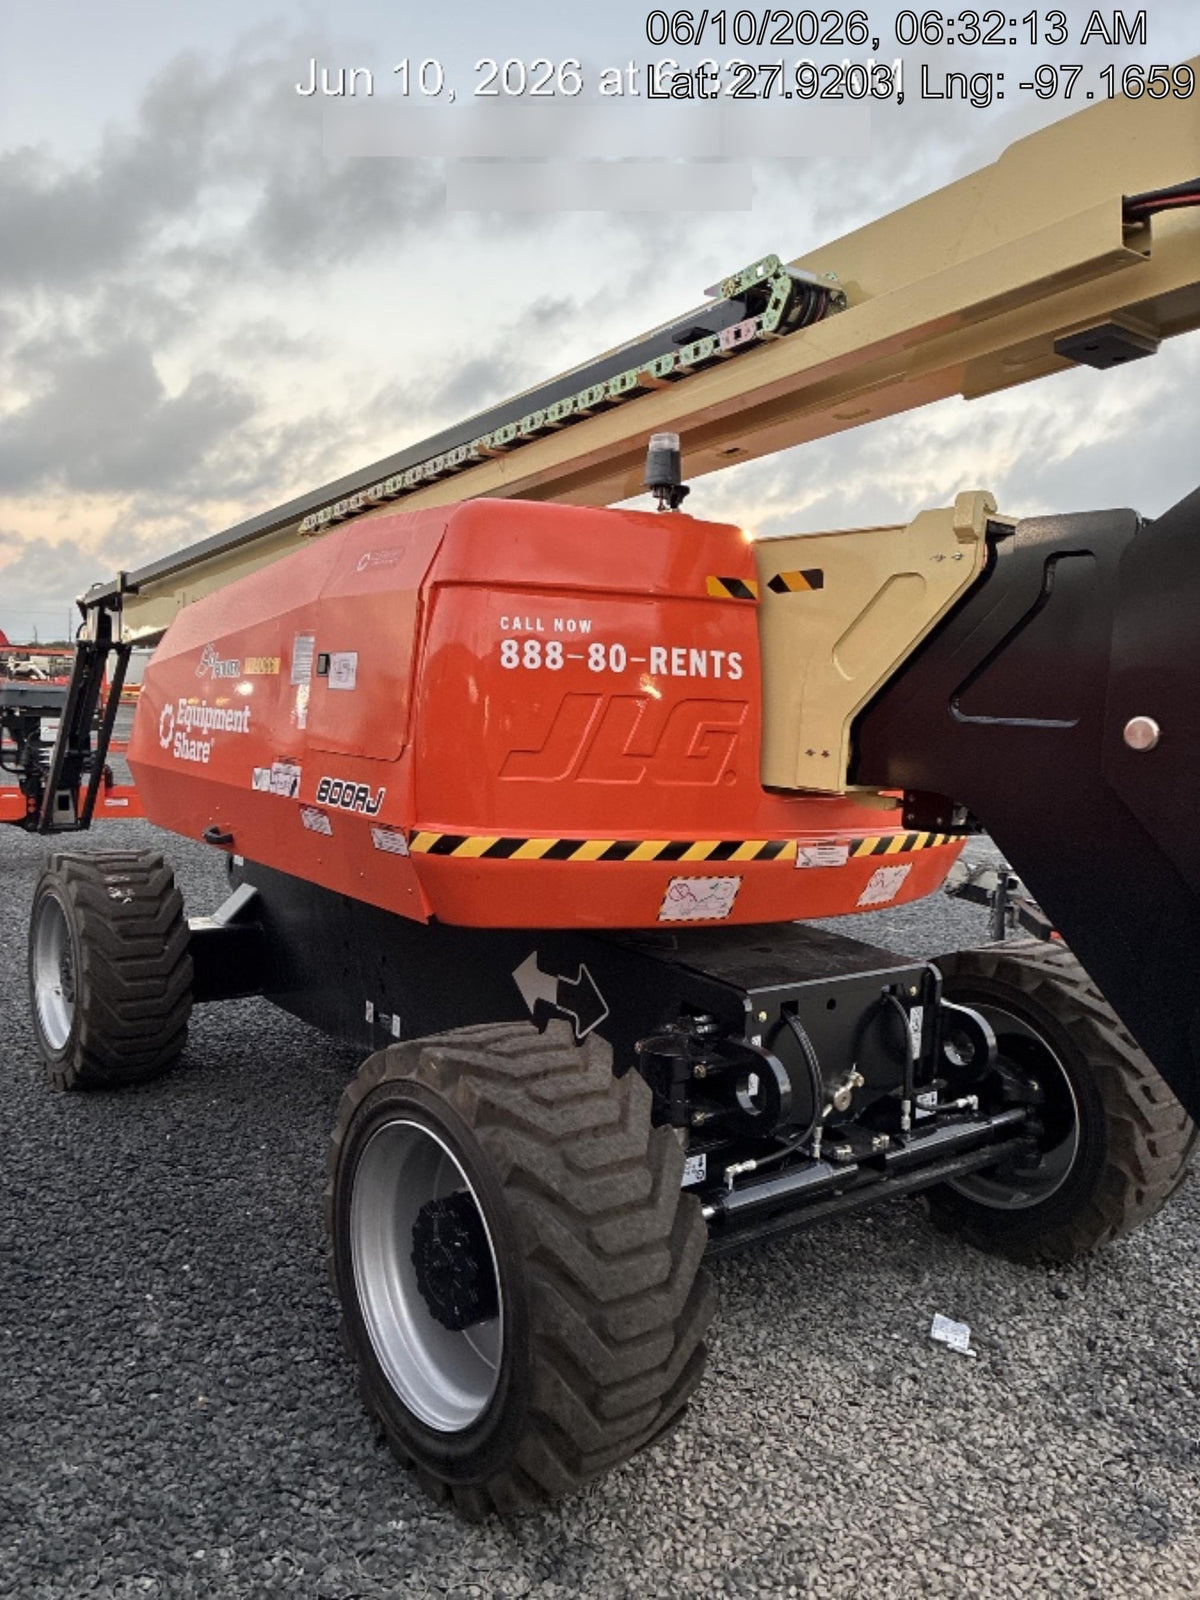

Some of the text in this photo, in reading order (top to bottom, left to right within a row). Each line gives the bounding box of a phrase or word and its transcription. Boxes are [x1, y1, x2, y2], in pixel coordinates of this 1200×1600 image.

[500, 616, 592, 633] CALL NOW
[500, 639, 743, 680] 888-80-RENTS
[176, 698, 251, 735] Equipment
[498, 691, 749, 785] JLG
[316, 776, 386, 816] 800AJ
